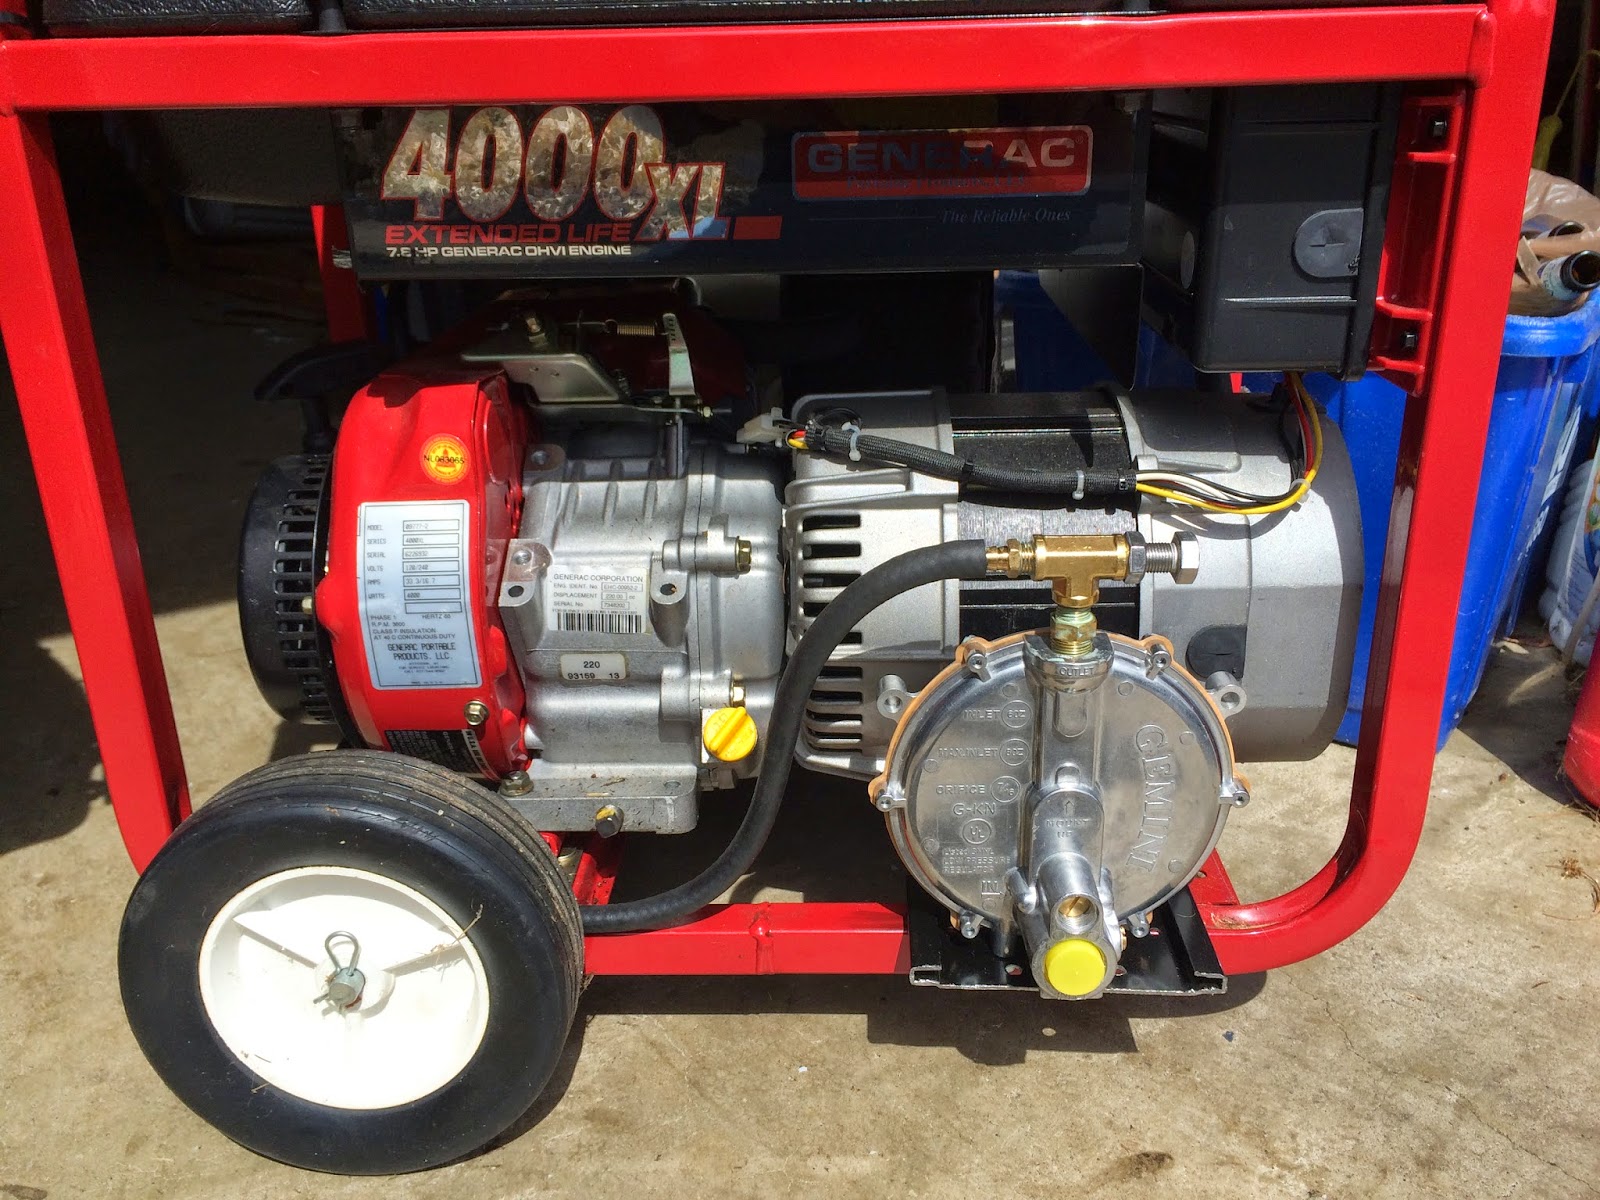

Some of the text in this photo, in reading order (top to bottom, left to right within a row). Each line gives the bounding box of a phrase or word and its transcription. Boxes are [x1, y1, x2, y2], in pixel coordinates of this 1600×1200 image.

[807, 138, 1076, 173] GENERAC
[941, 208, 1072, 224] The Reliable Ones
[385, 223, 633, 244] EXTENDED LIFE
[414, 246, 439, 257] HP
[441, 246, 524, 257] GENERAC
[525, 246, 567, 257] OHVI
[568, 245, 632, 256] ENGINE
[553, 573, 644, 583] GENERAC CORPORATION
[387, 642, 457, 651] GENERAC PORTABLE
[583, 660, 601, 669] 220
[567, 672, 620, 680] 93159 13
[1059, 666, 1095, 677] OUTLET
[963, 709, 1001, 721] INLET
[935, 784, 986, 796] ORIFICE
[1126, 724, 1176, 872] GEMINI
[952, 801, 997, 816] G-KN
[1046, 819, 1092, 829] MOUNT
[965, 856, 1012, 865] PRESSURE
[980, 880, 999, 892] IN
